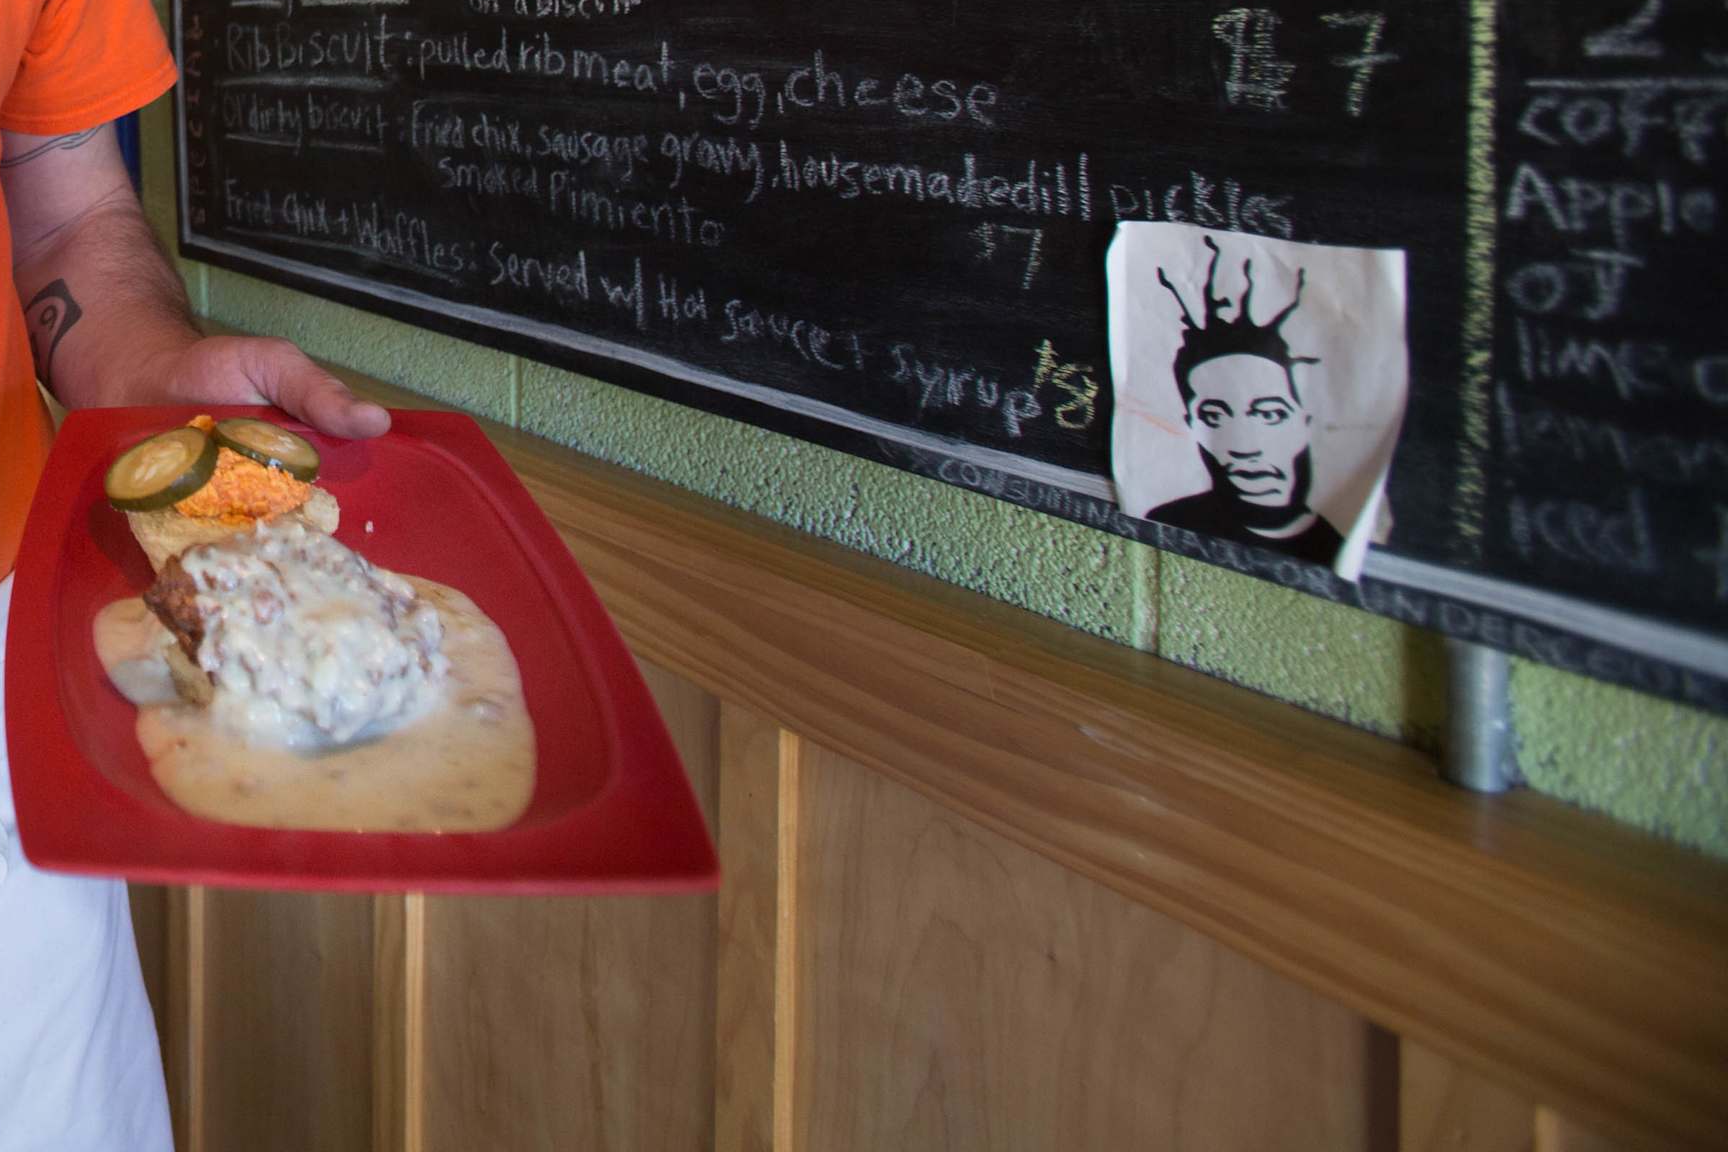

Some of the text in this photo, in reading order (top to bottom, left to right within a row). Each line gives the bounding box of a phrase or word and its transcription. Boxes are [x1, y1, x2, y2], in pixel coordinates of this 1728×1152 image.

[419, 26, 511, 81] pulled
[519, 32, 566, 75] rib
[784, 49, 999, 127] cheese
